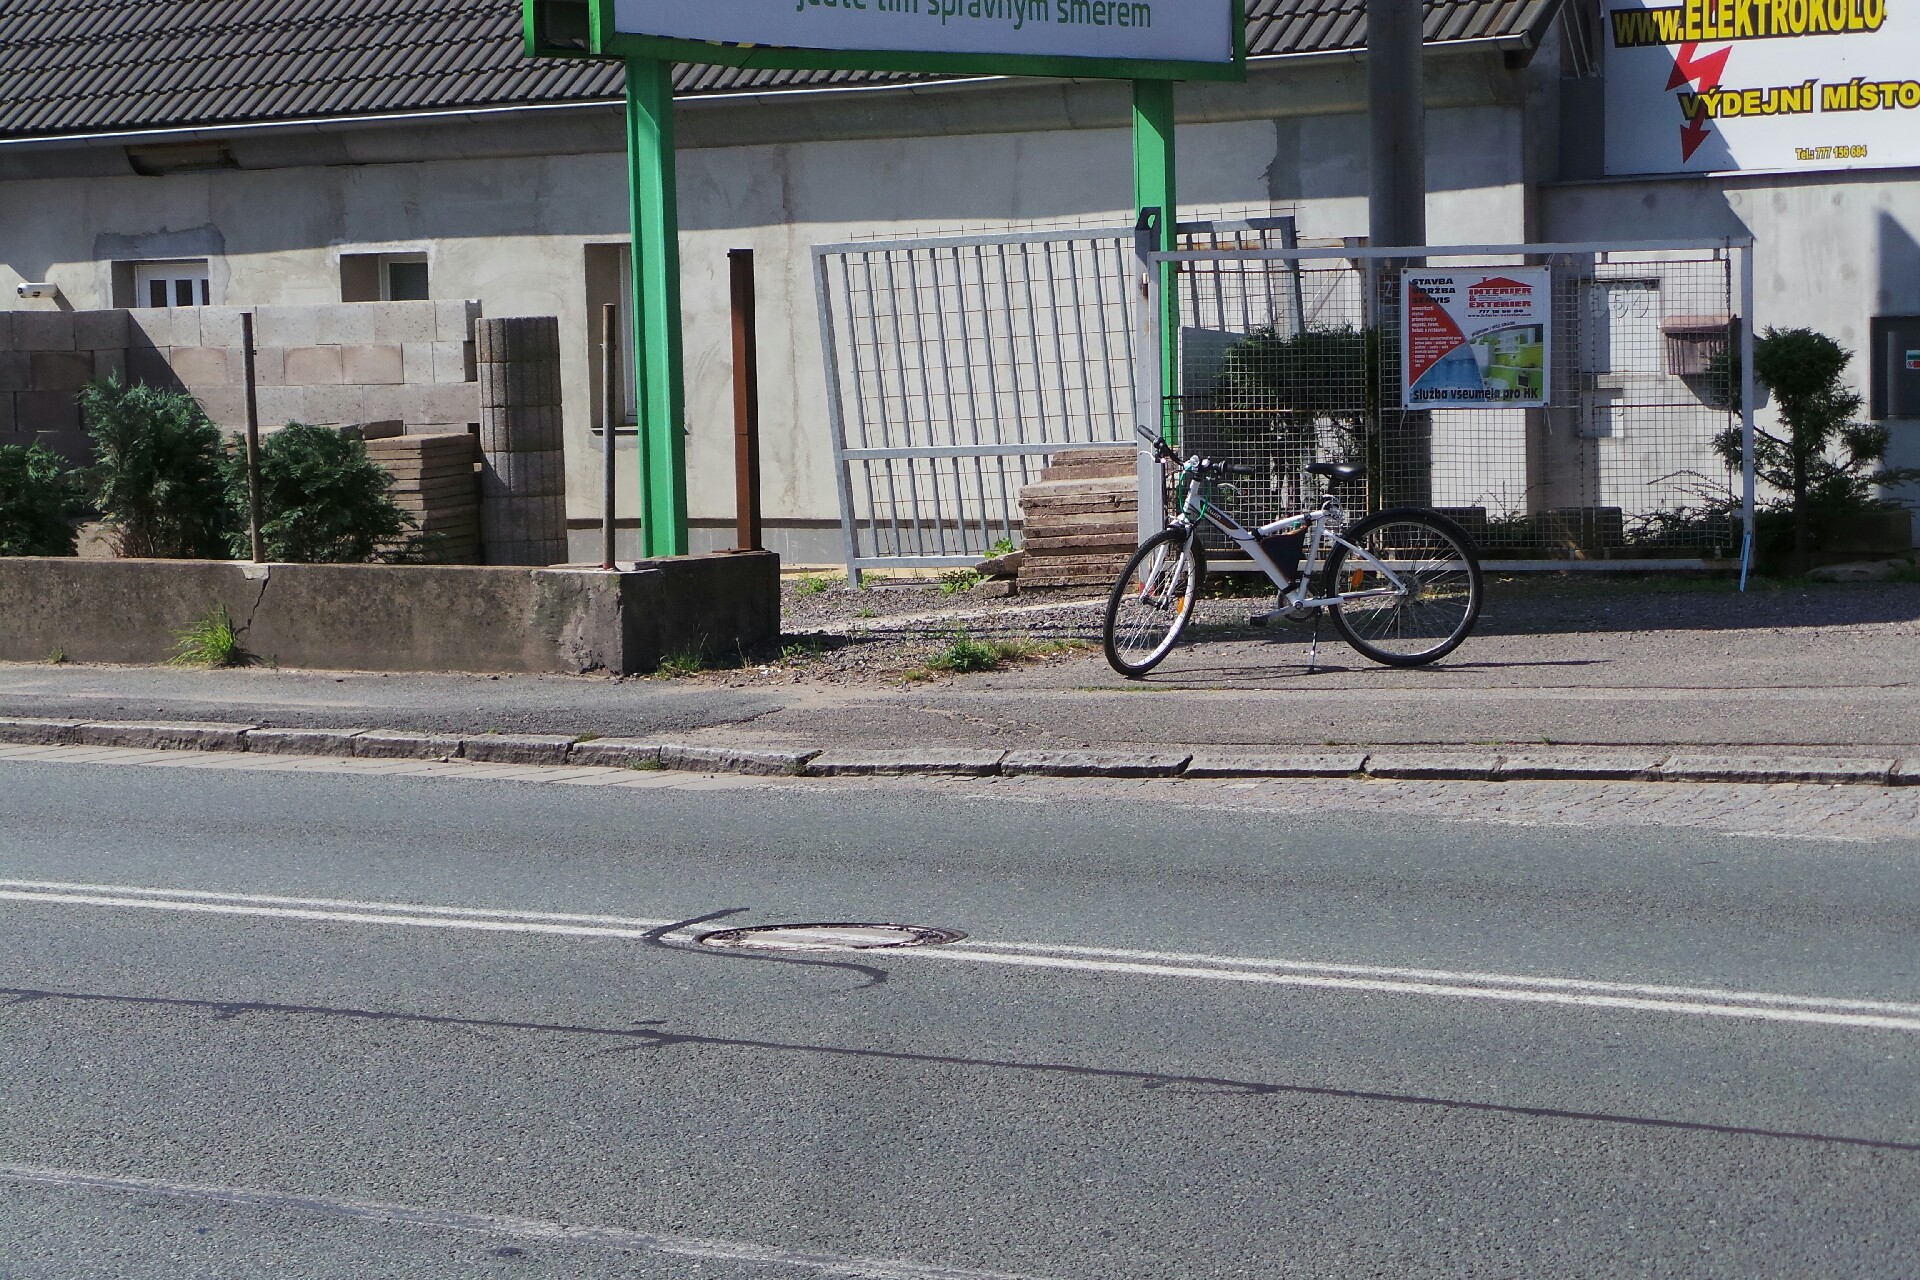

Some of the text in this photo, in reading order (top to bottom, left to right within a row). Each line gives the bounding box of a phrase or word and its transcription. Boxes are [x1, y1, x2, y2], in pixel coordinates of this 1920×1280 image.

[1680, 77, 1920, 120] VÝDEJNÍ MÍSTO
[1815, 147, 1832, 159] 777
[1833, 146, 1849, 158] 156
[1850, 145, 1867, 157] 684
[1413, 387, 1448, 400] služba
[1502, 389, 1520, 400] pro
[1523, 388, 1538, 399] HK
